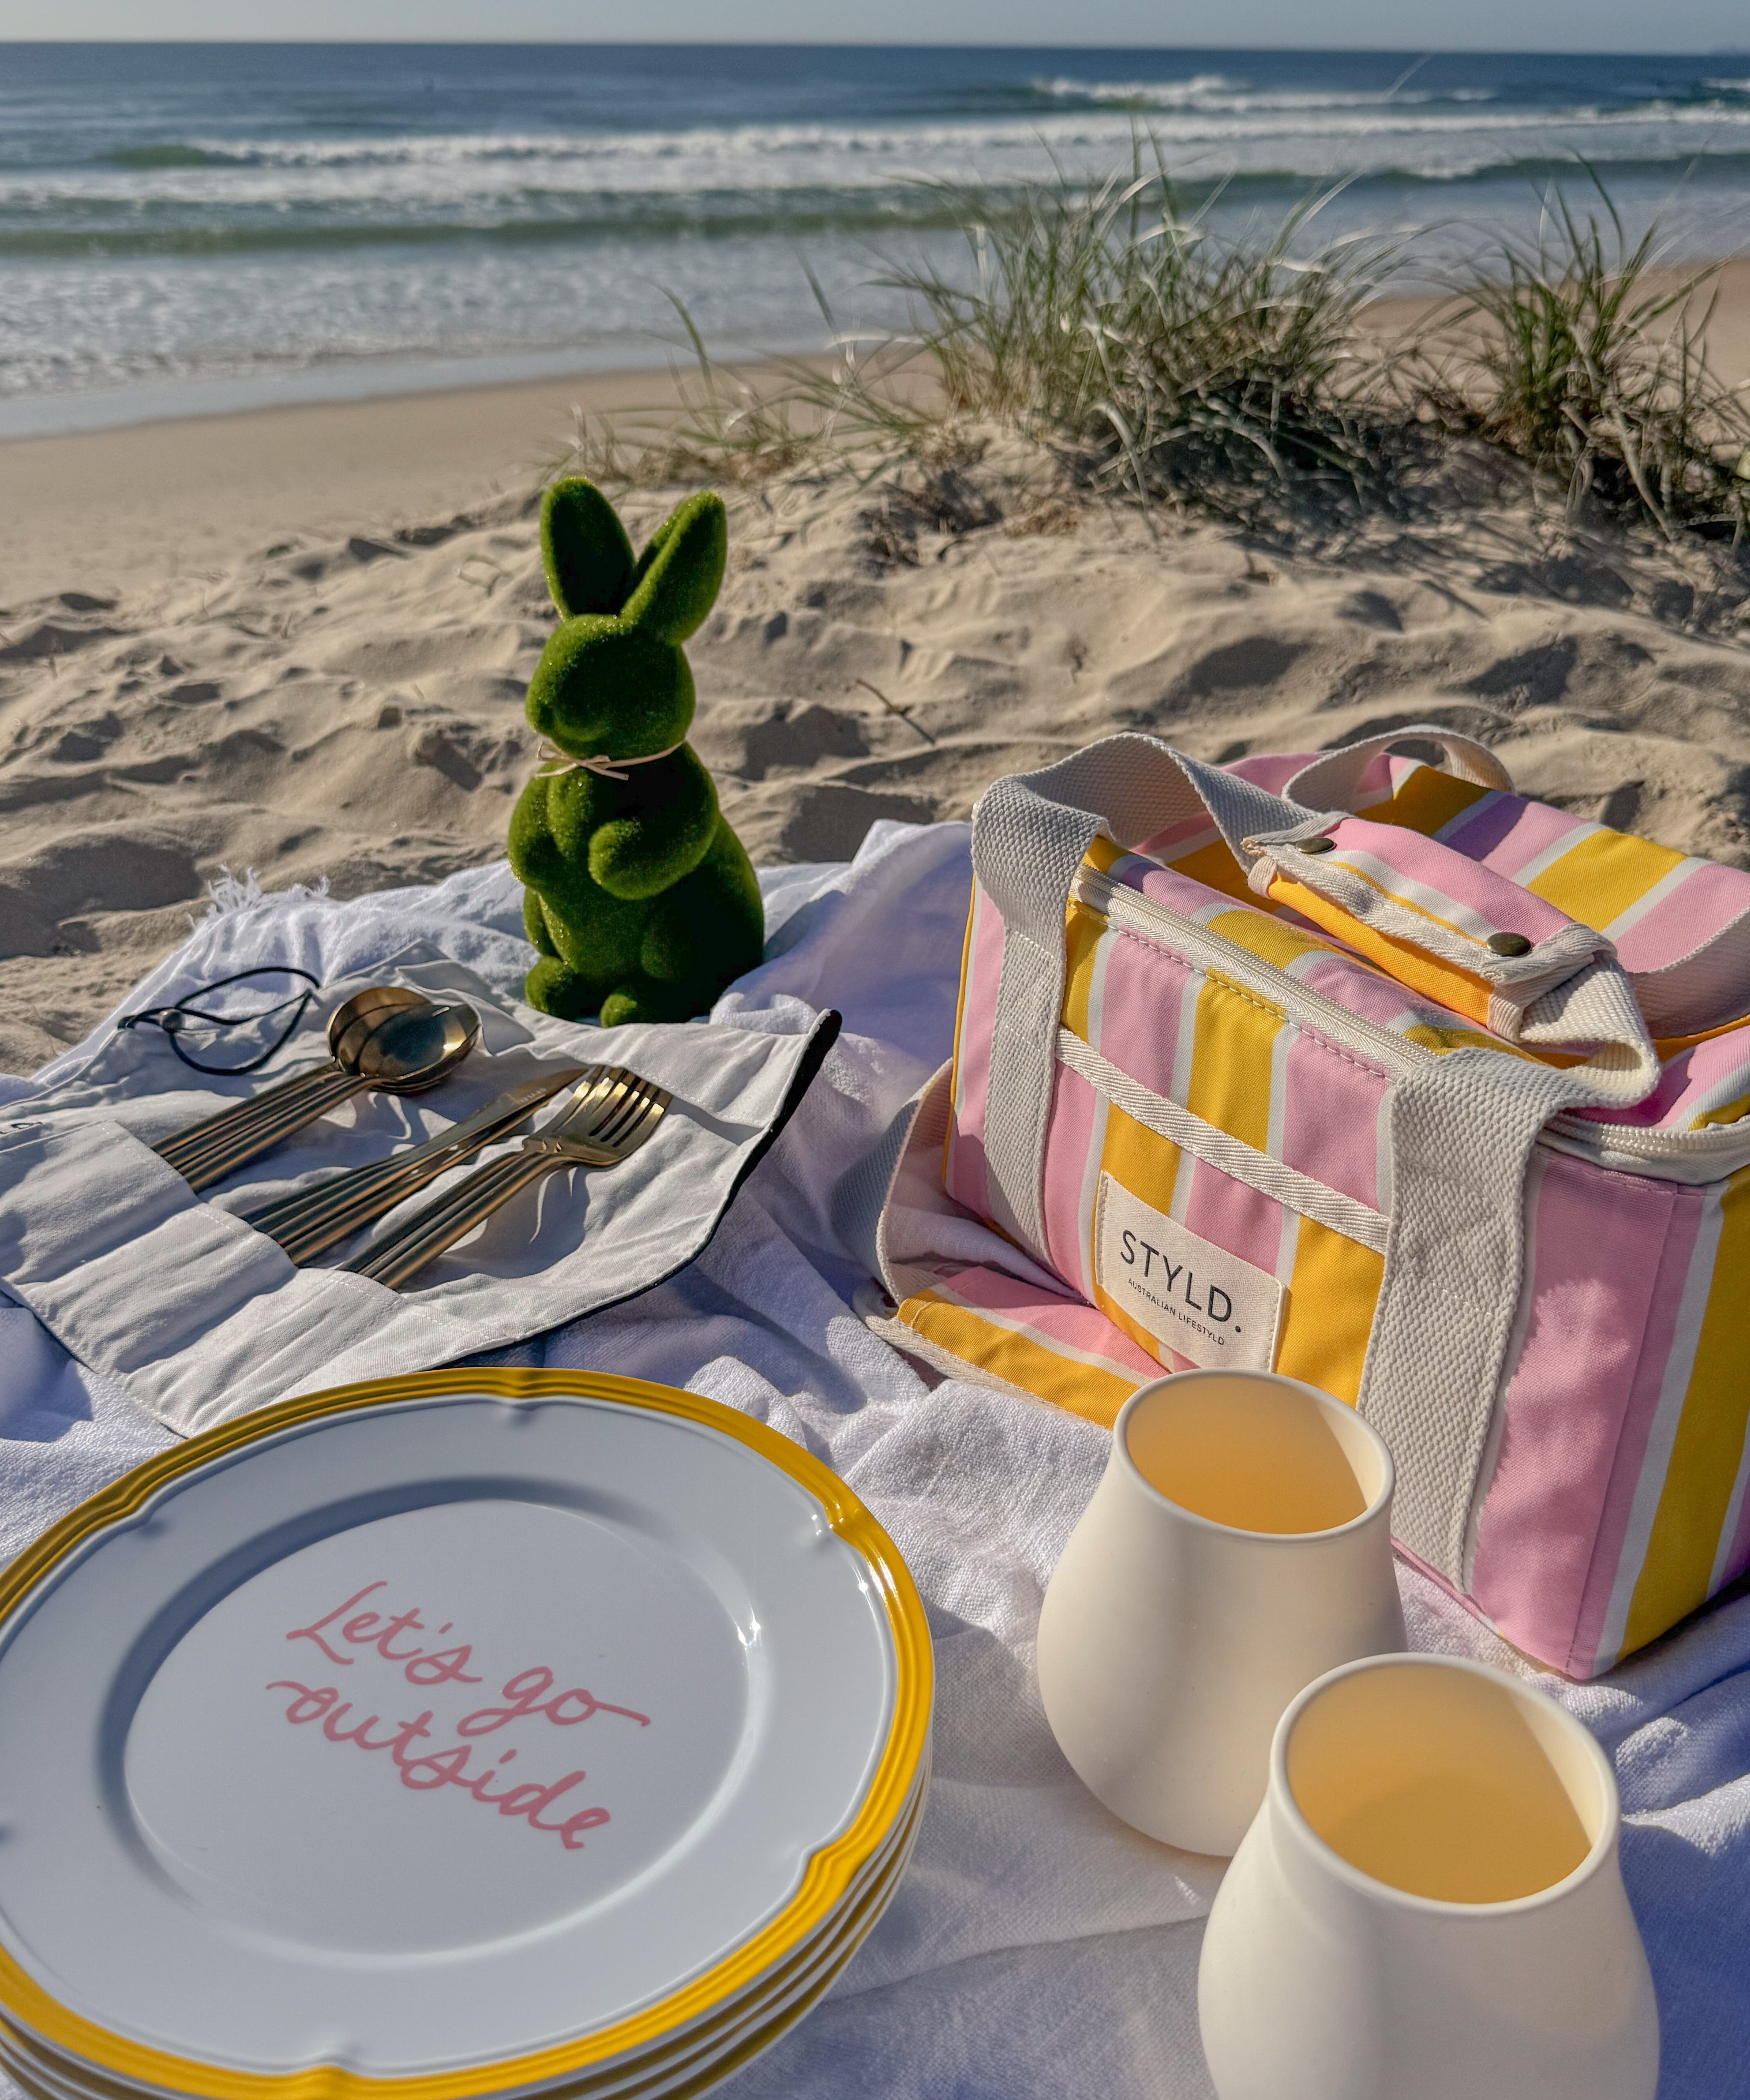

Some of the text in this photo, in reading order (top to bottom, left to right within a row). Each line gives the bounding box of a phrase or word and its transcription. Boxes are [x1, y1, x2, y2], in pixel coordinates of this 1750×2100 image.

[1128, 1278, 1224, 1345] AUSTRALIAN LIFESTYLD
[286, 1581, 651, 1736] Let's go
[265, 1681, 610, 1849] outside
